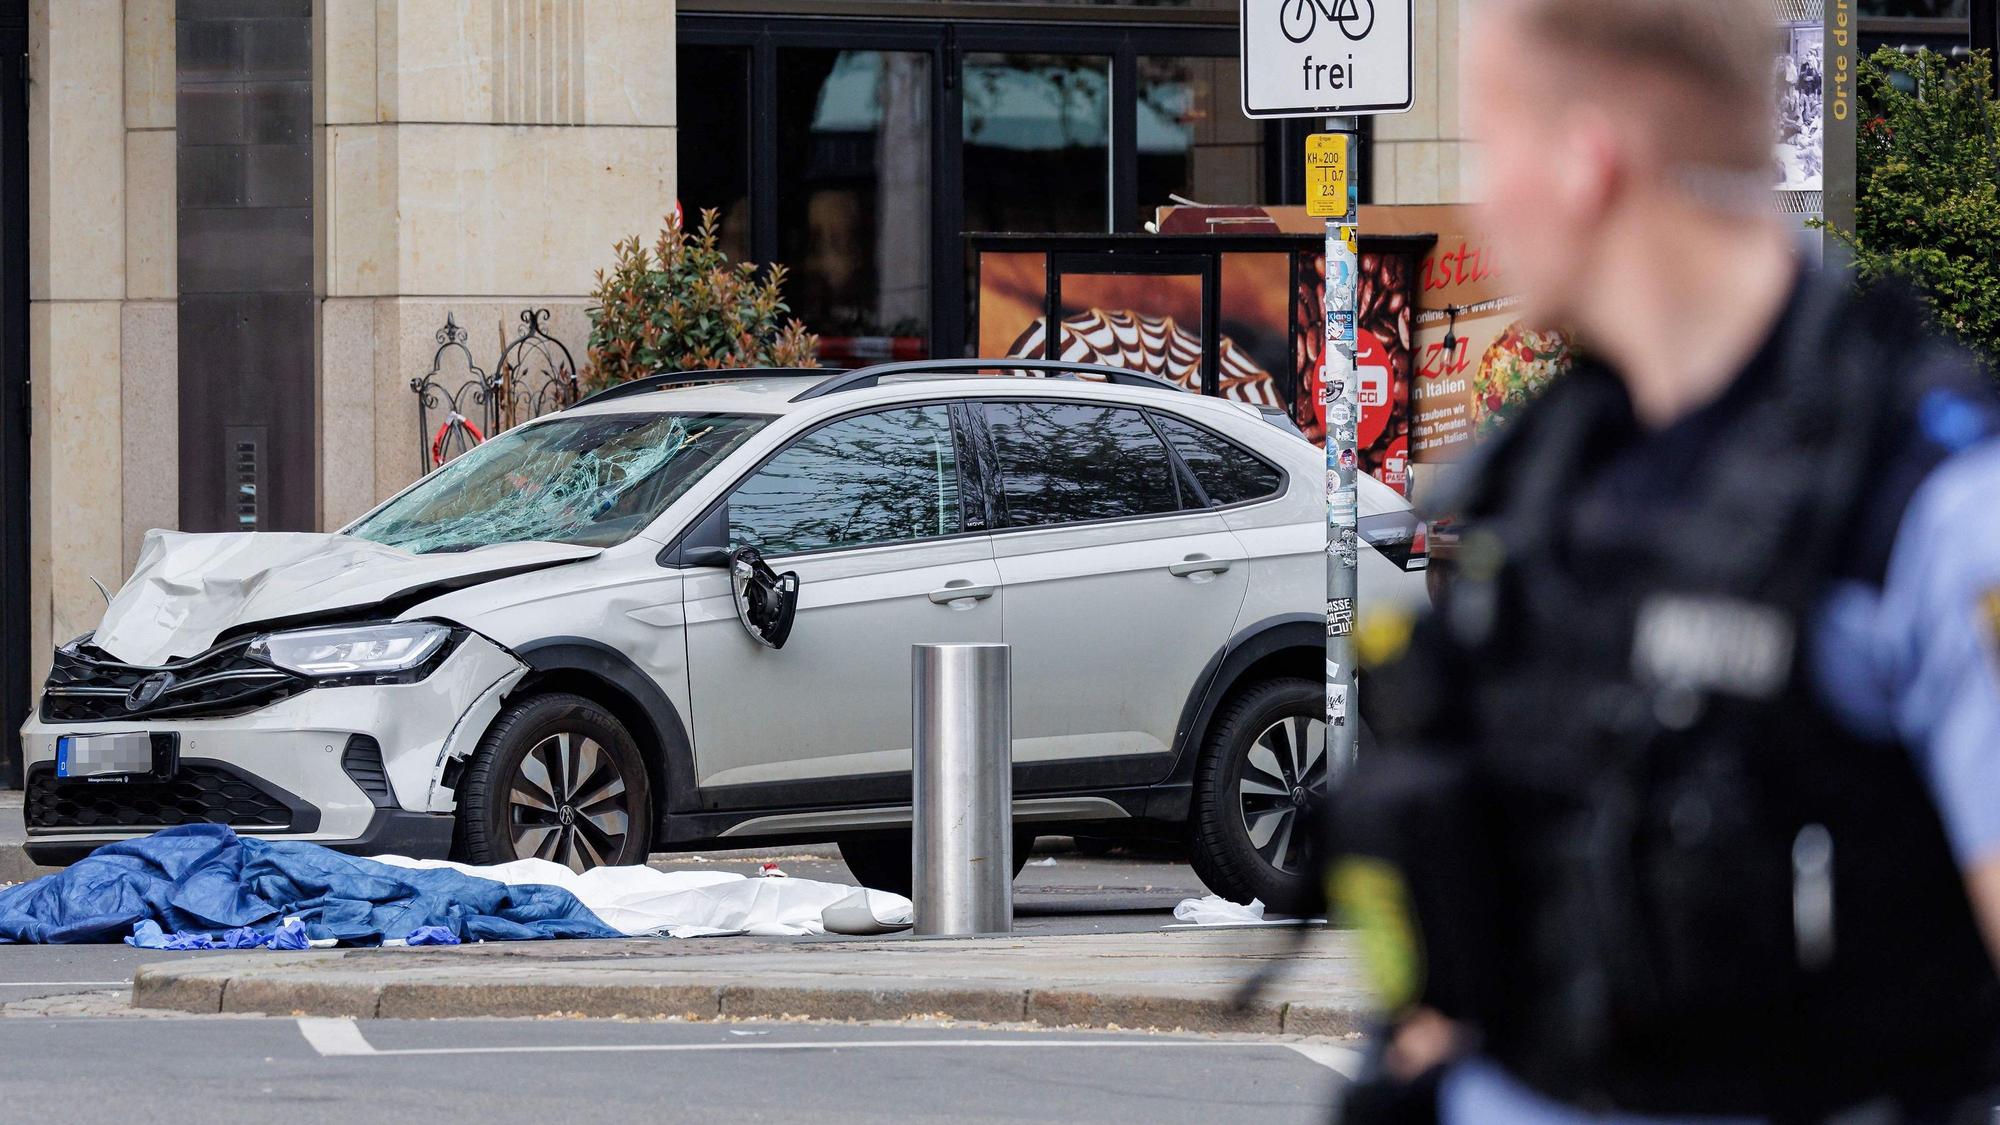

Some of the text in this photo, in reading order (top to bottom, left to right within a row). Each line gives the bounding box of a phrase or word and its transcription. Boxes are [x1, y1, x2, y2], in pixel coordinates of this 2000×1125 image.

[1303, 54, 1353, 90] frei
[1834, 55, 1848, 120] Orte
[1307, 152, 1339, 164] KH 200
[1322, 184, 1335, 197] 2.3
[1328, 312, 1352, 322] Klang
[1426, 379, 1466, 398] Italien
[1420, 407, 1452, 422] zaubern
[1452, 402, 1466, 415] wir
[1433, 418, 1467, 434] Tomaten
